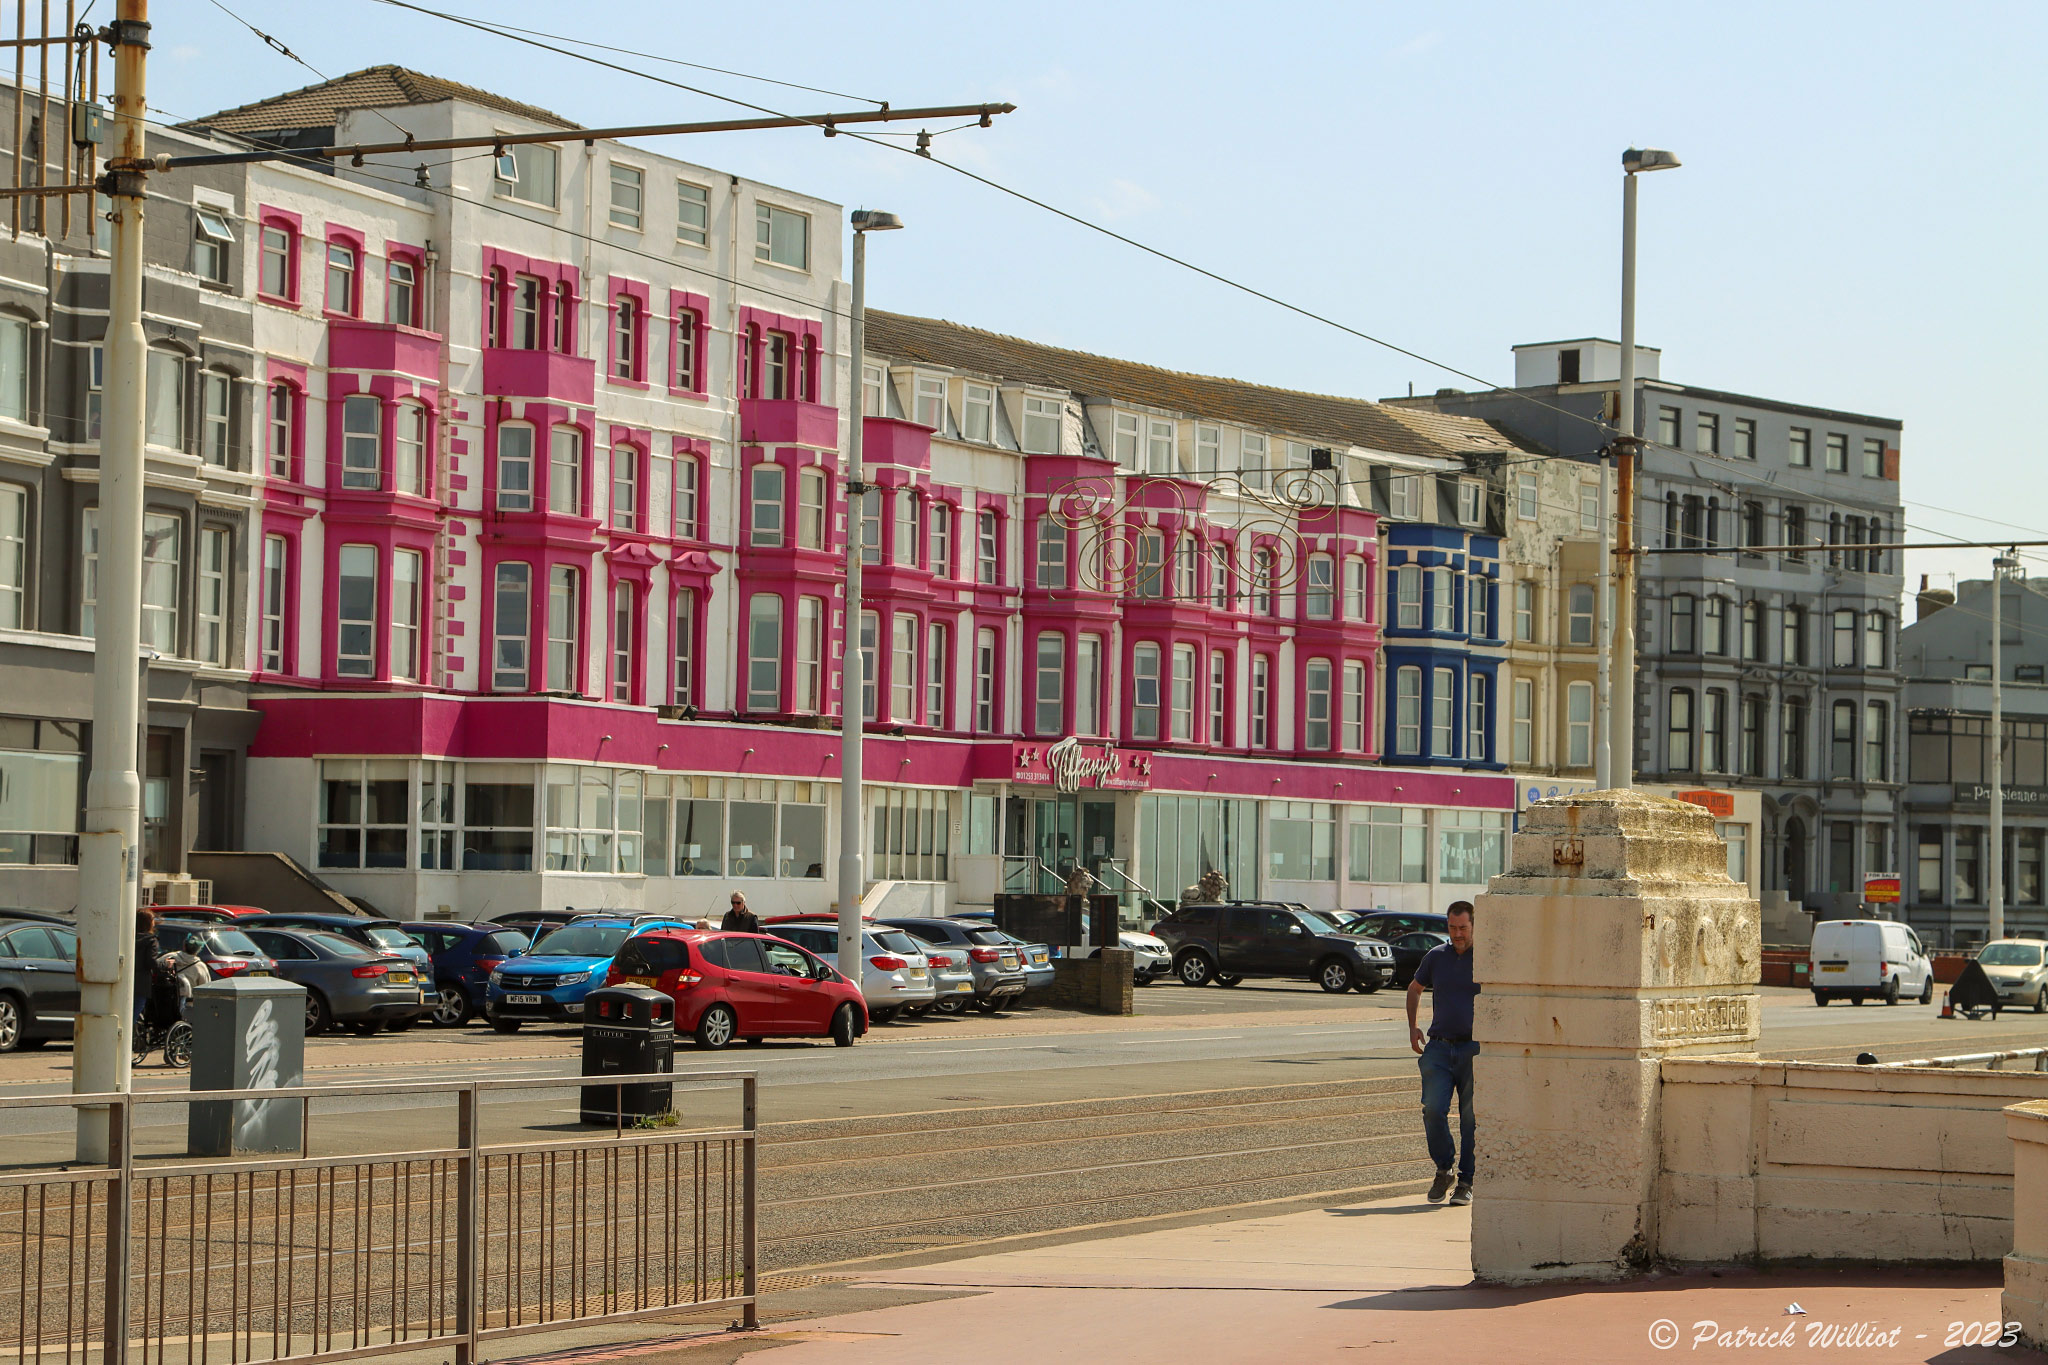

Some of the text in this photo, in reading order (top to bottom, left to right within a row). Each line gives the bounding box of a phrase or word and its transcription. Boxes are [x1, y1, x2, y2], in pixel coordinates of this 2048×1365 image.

[1047, 736, 1121, 793] Tiffany's
[1974, 786, 2037, 802] Pasienne
[1711, 796, 1729, 807] HOTEL
[599, 1030, 624, 1038] LITTER
